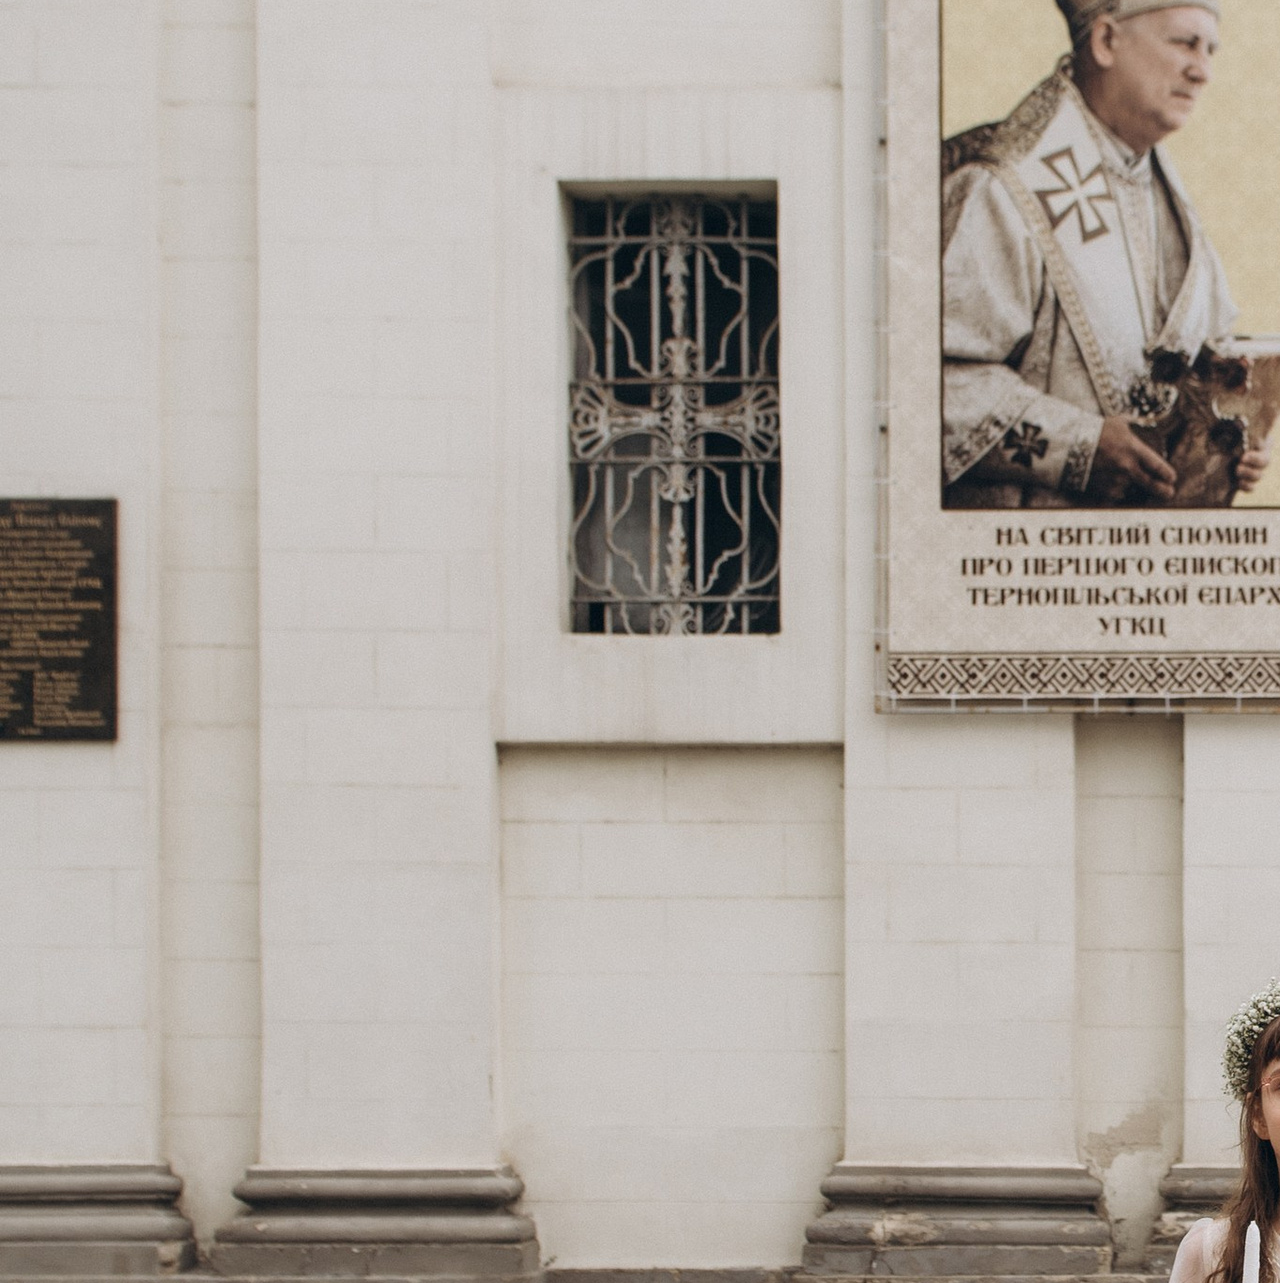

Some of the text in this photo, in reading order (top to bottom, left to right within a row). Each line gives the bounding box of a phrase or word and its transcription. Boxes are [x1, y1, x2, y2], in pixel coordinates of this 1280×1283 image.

[995, 522, 1269, 547] НА СВІТЛИЙ СПОМИН
[960, 556, 1013, 578] ПРО
[1022, 555, 1155, 578] ПЕРШОГО
[966, 583, 1190, 607] ТЕРНОПІЛЬСЬКОЇ
[1097, 615, 1167, 638] УГКЦ
